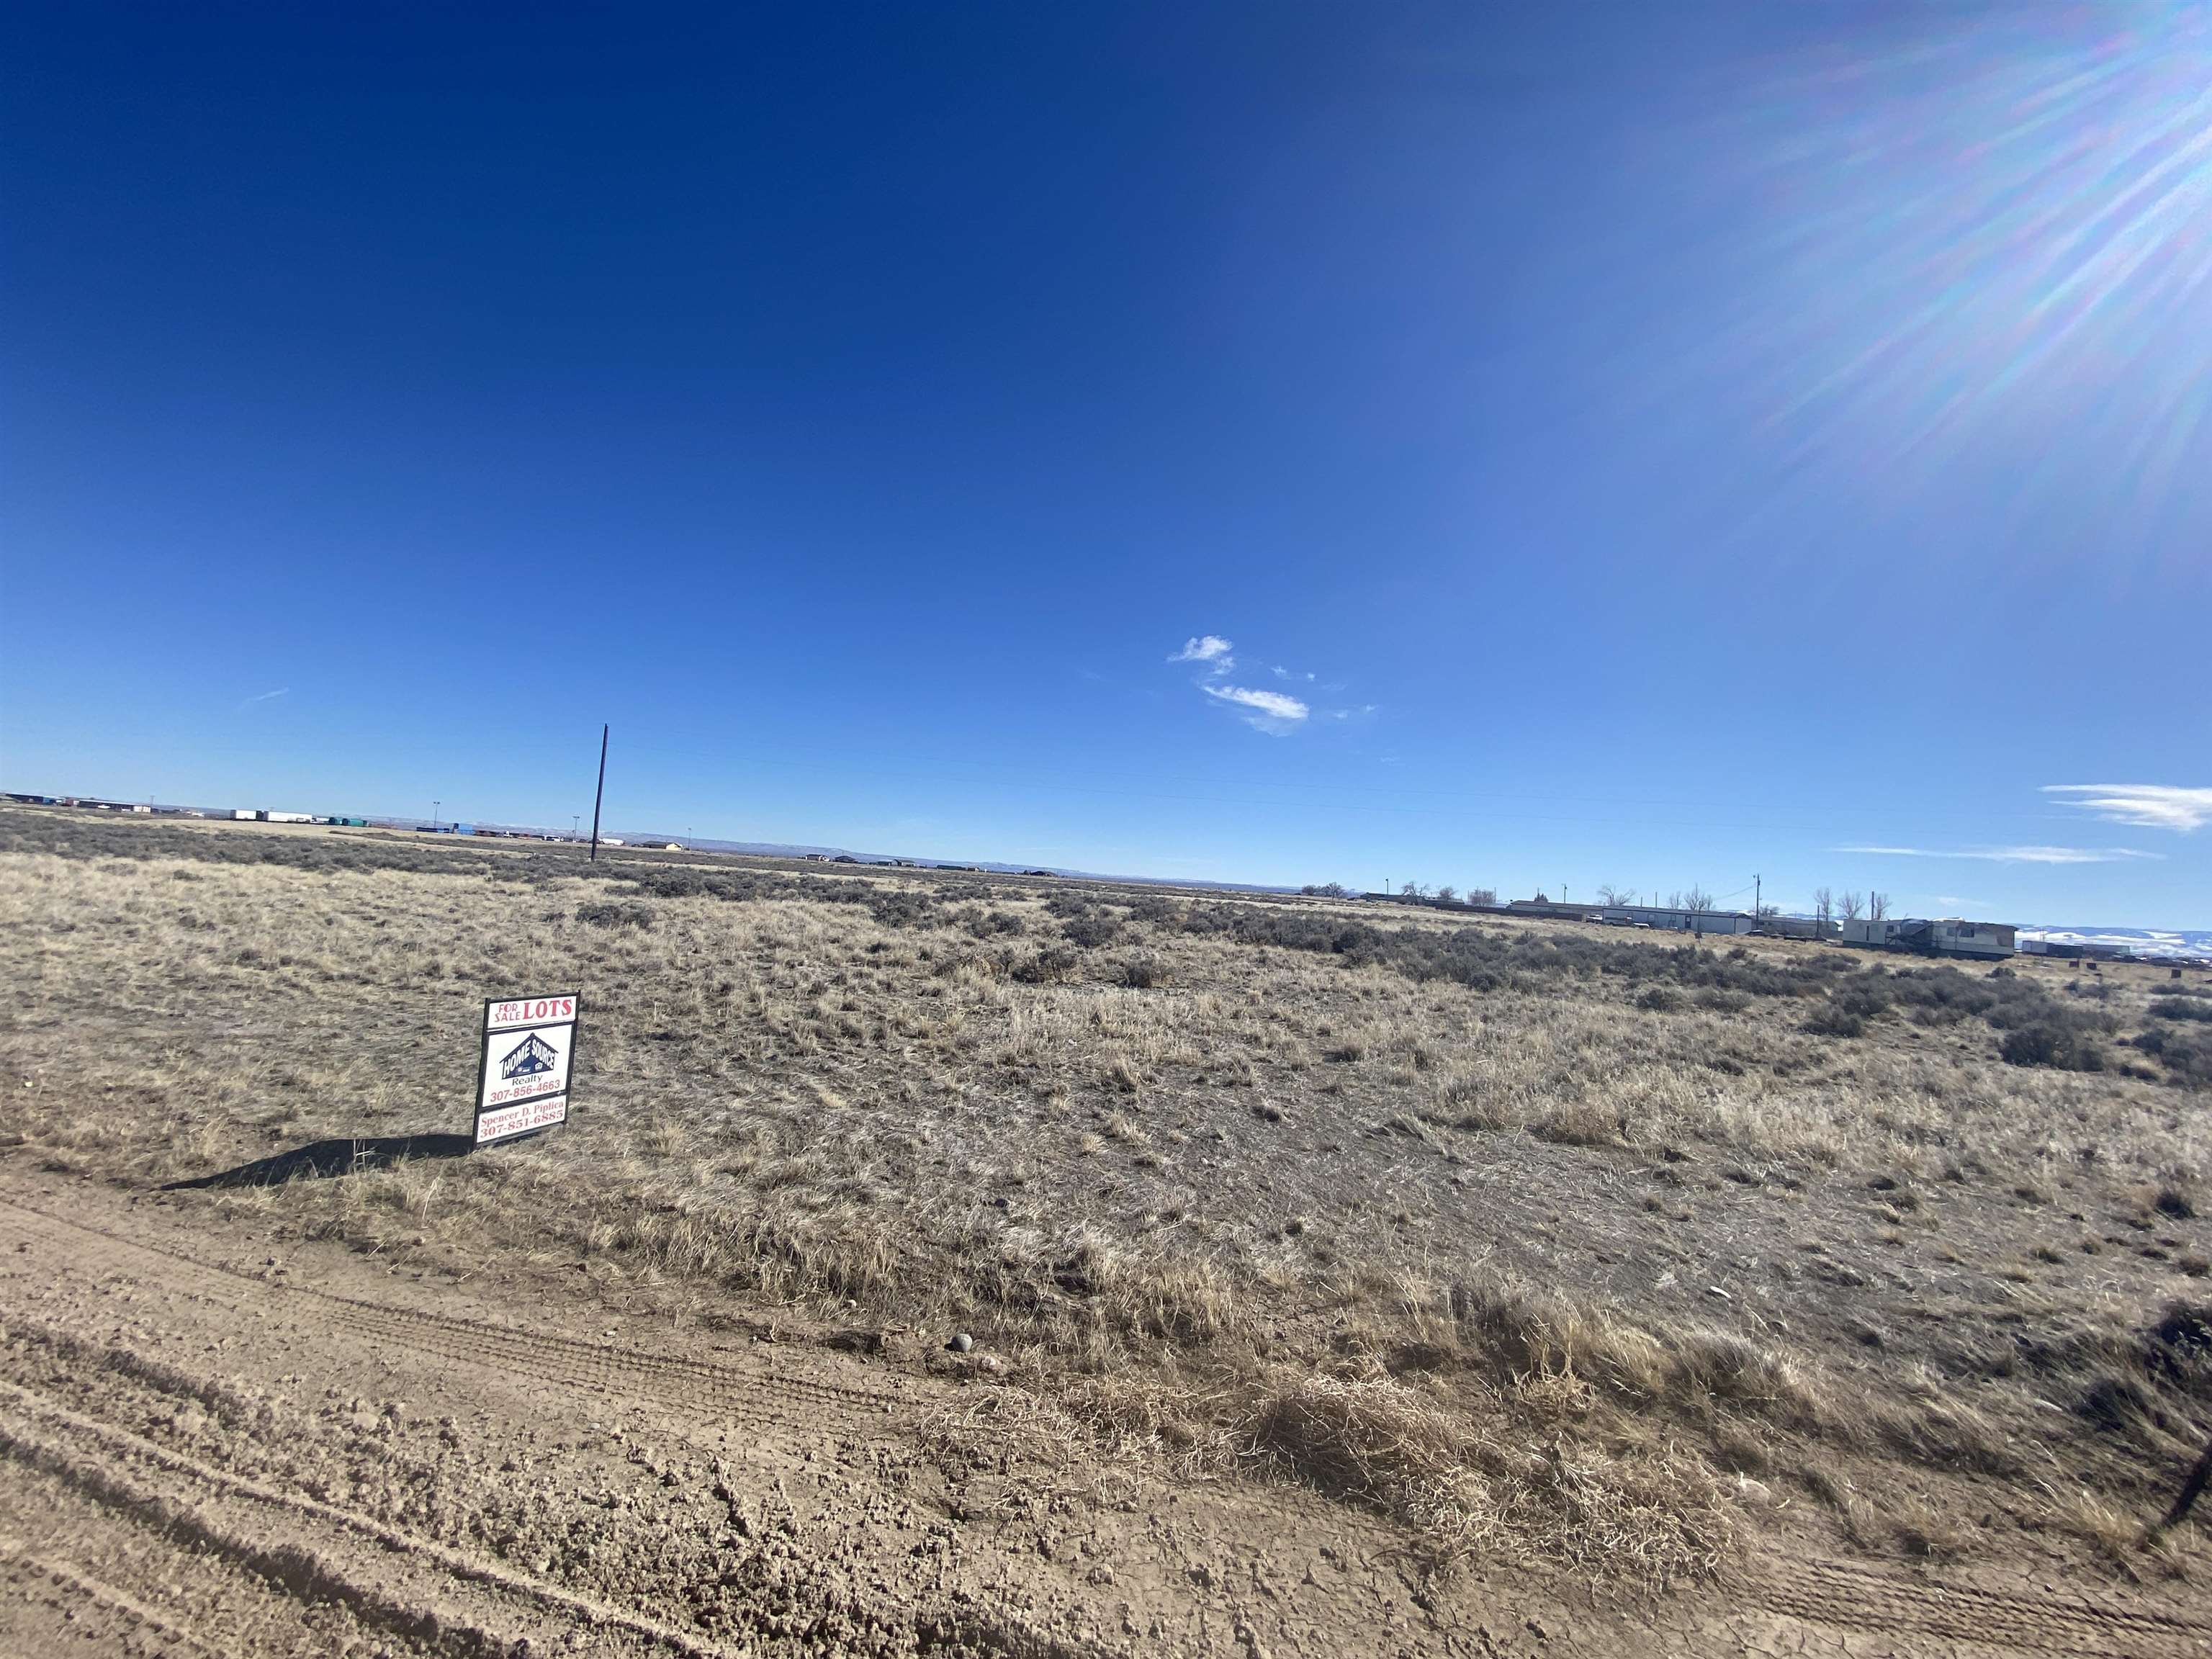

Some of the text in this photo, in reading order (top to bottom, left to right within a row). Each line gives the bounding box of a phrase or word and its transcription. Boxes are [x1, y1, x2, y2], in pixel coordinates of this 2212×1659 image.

[495, 1012, 521, 1022] SALE
[499, 1004, 518, 1013] FOR
[523, 999, 572, 1020] LOTS
[503, 1038, 554, 1078] HOME SOURCE
[512, 1074, 543, 1086] Realty
[490, 1079, 560, 1102] 307-856-4663
[480, 1110, 563, 1138] 307-851-6885
[481, 1110, 518, 1127] Spencer
[522, 1107, 531, 1117] D.
